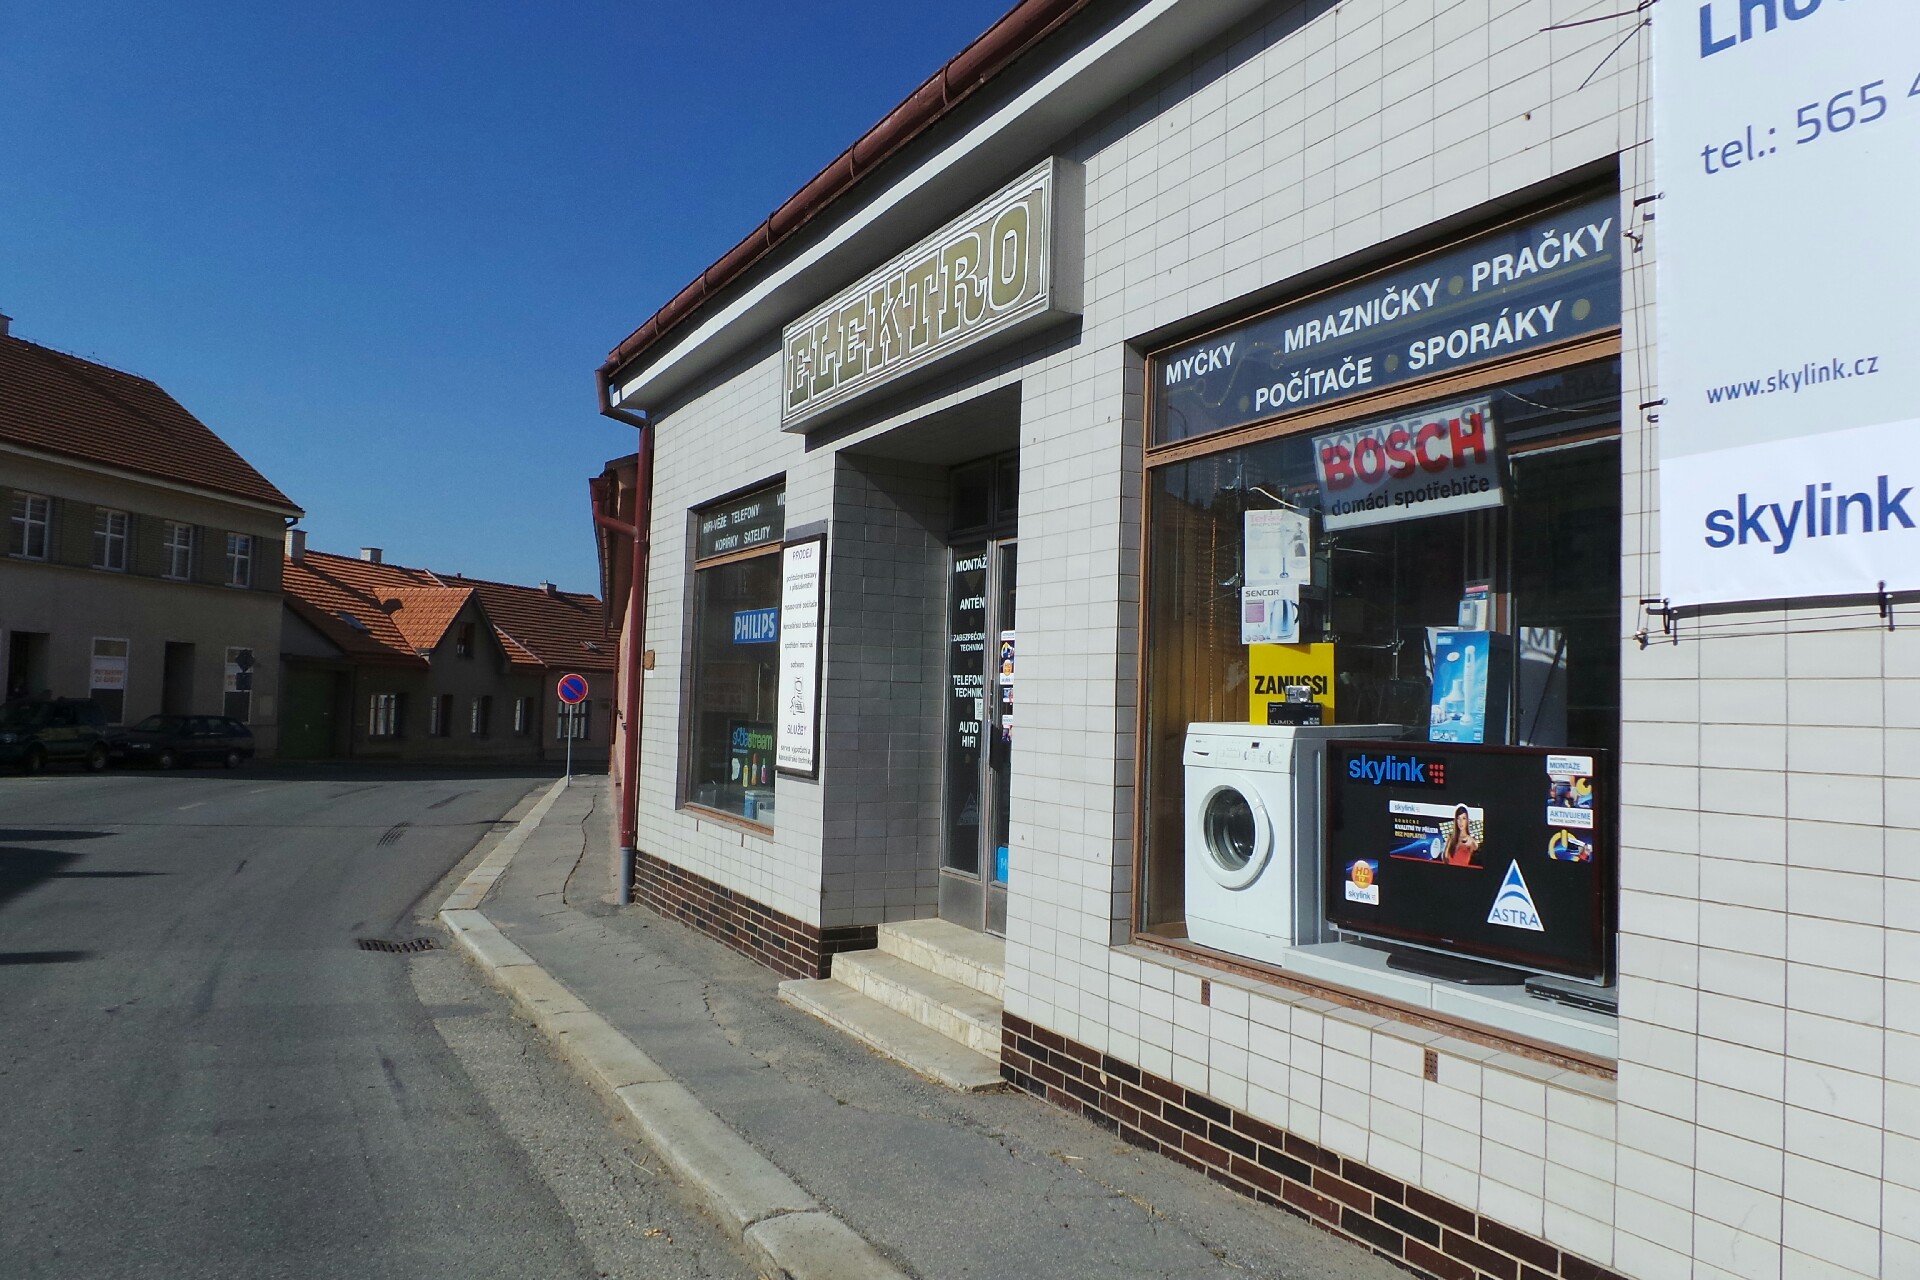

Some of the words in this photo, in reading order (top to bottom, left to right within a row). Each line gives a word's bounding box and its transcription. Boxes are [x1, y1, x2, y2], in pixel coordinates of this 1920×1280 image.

[1700, 125, 1776, 174] tel.:
[1796, 80, 1887, 145] 565
[788, 201, 1029, 411] ELEKTRO
[1165, 342, 1236, 386] MYČKY
[1284, 277, 1440, 354] MRAZNIČKY
[1471, 217, 1613, 292] PRAČKY
[1255, 355, 1373, 412] POČÍTAČE
[1408, 300, 1562, 370] SPORÁKY
[1706, 356, 1879, 404] www.skylink.cz
[1321, 412, 1487, 491] BOSCH
[1394, 474, 1490, 508] spotřebiče
[731, 504, 760, 524] TELEFONY
[1704, 474, 1917, 555] skylink
[743, 525, 771, 544] SATELITY
[959, 594, 985, 610] ANTÉN
[1245, 589, 1279, 597] SENCOR
[734, 612, 775, 640] PHILIPS
[960, 643, 984, 652] TECHNIKA
[1254, 674, 1328, 695] ZANUSSI
[958, 721, 979, 734] AUTO
[961, 735, 976, 749] HIFI
[1349, 754, 1425, 785] skylink
[1394, 804, 1416, 812] skylink
[1355, 866, 1369, 876] HD
[1348, 889, 1371, 900] skylink
[1492, 907, 1540, 927] ASTRA
